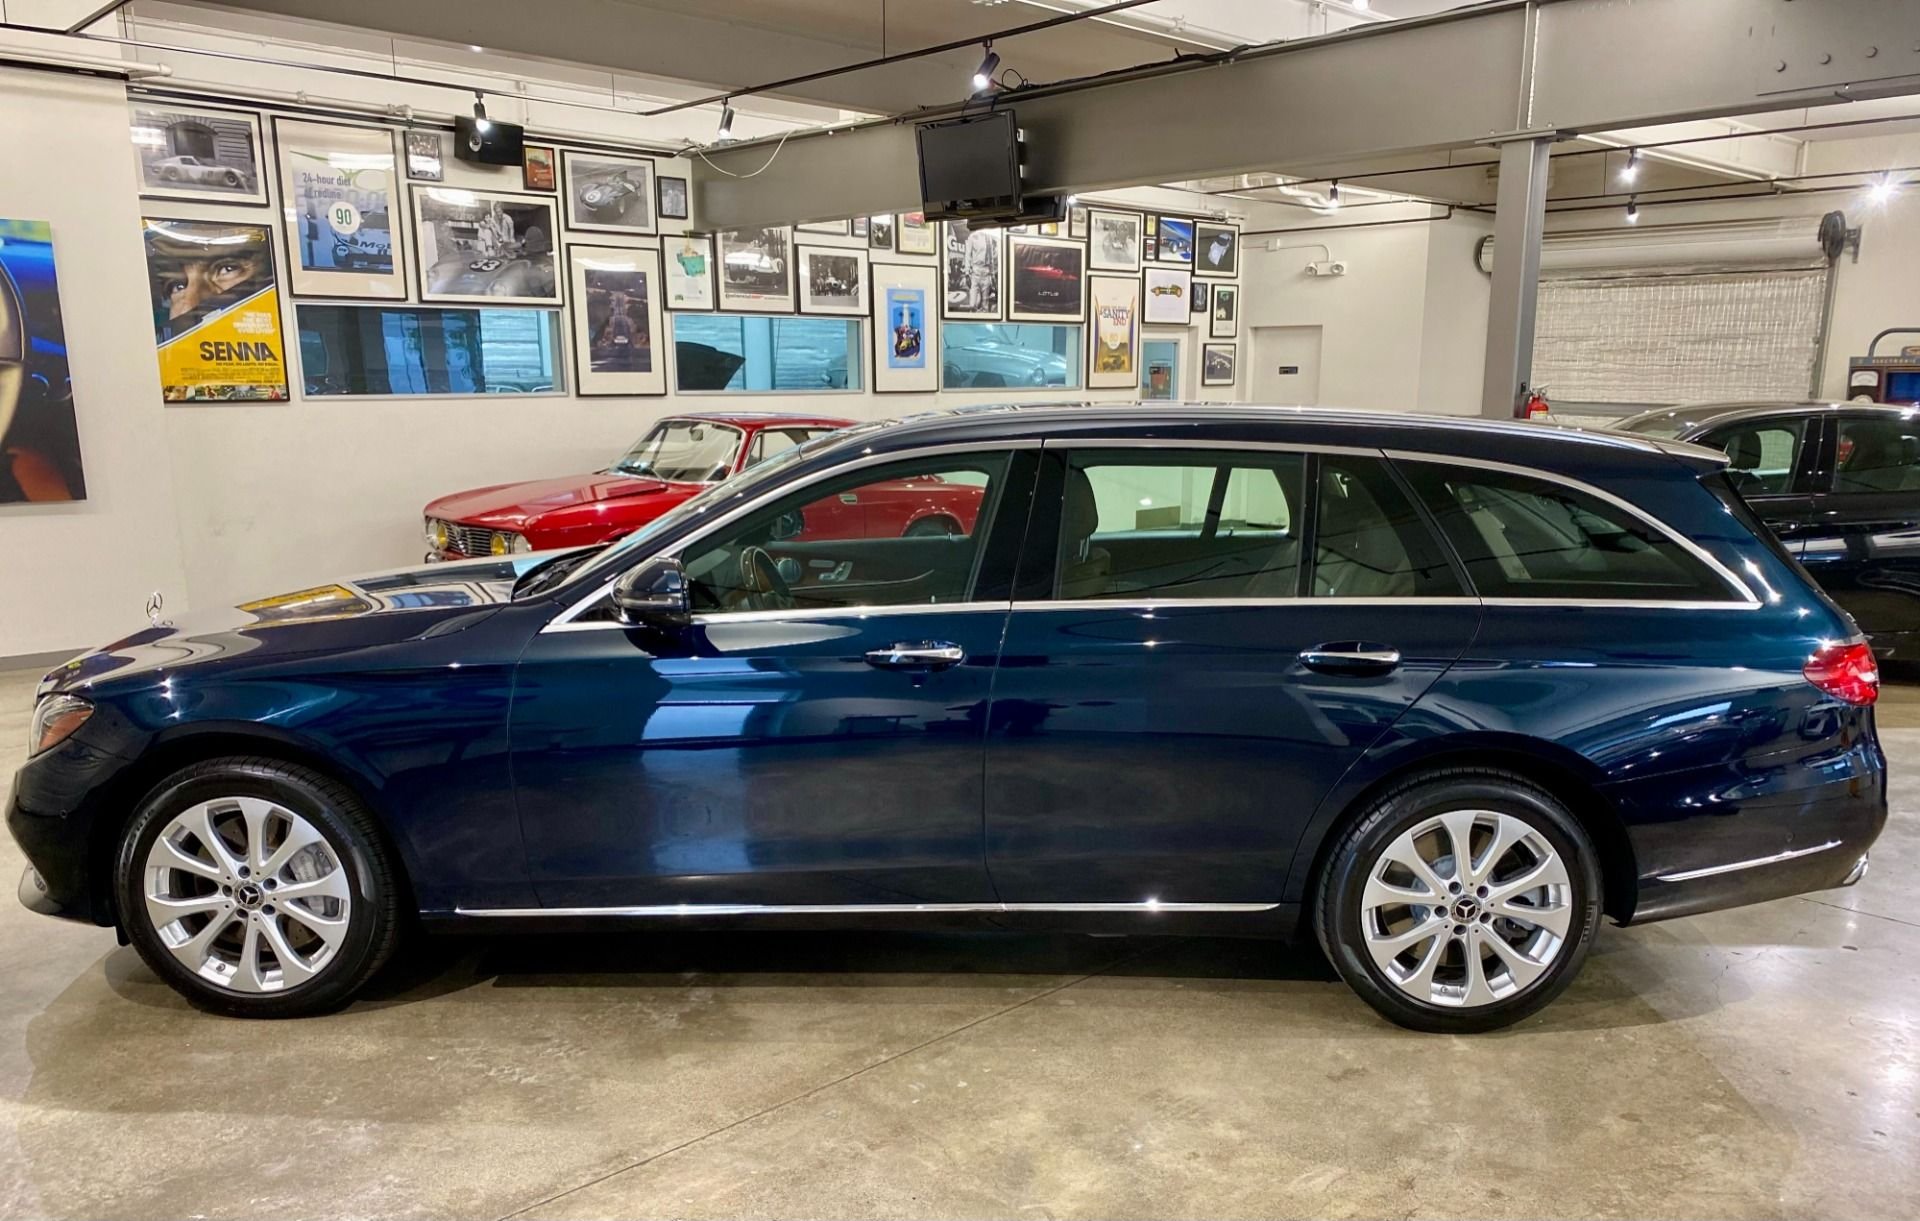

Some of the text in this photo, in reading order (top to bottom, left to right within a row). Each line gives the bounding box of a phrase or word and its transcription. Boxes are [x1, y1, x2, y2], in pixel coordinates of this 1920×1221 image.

[302, 172, 334, 185] 24-hour
[336, 208, 352, 225] 90
[470, 259, 500, 271] 33
[1103, 308, 1130, 320] SANITY
[200, 341, 279, 361] SENNA
